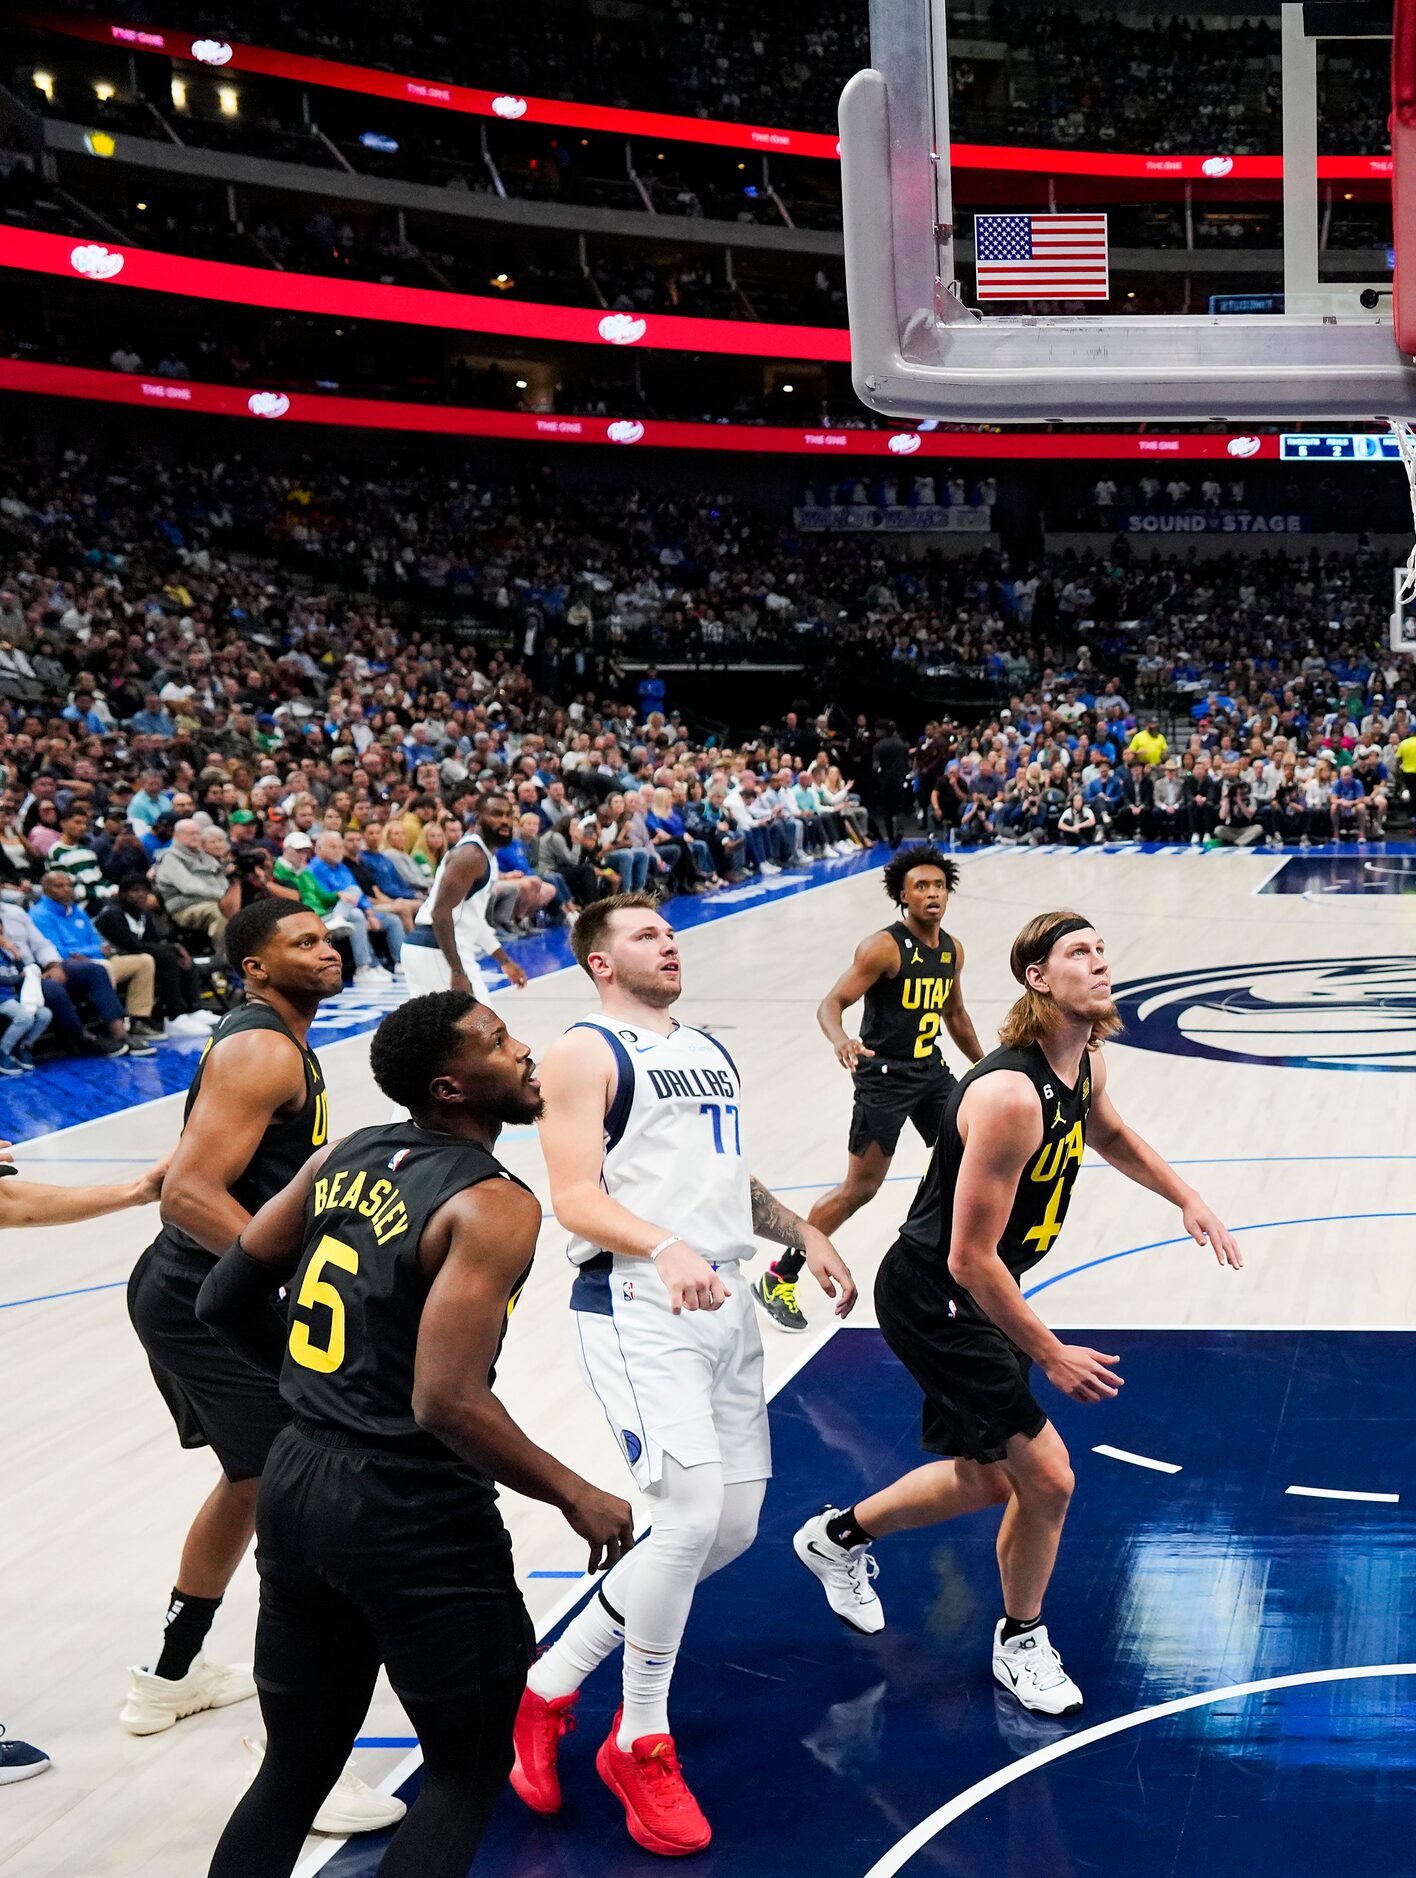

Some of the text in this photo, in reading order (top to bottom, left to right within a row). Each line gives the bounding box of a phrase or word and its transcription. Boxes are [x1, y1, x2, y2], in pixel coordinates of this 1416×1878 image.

[537, 420, 558, 432] THE
[804, 434, 847, 446] THE ONE
[1138, 440, 1179, 450] THE ONE
[1129, 505, 1301, 532] SOUND STAGE
[913, 1012, 941, 1059] 2
[647, 1068, 735, 1100] DALLAS
[1043, 1084, 1055, 1100] 6
[700, 1103, 742, 1157] 77
[314, 1170, 409, 1246] BEASLEY
[288, 1233, 360, 1374] 5
